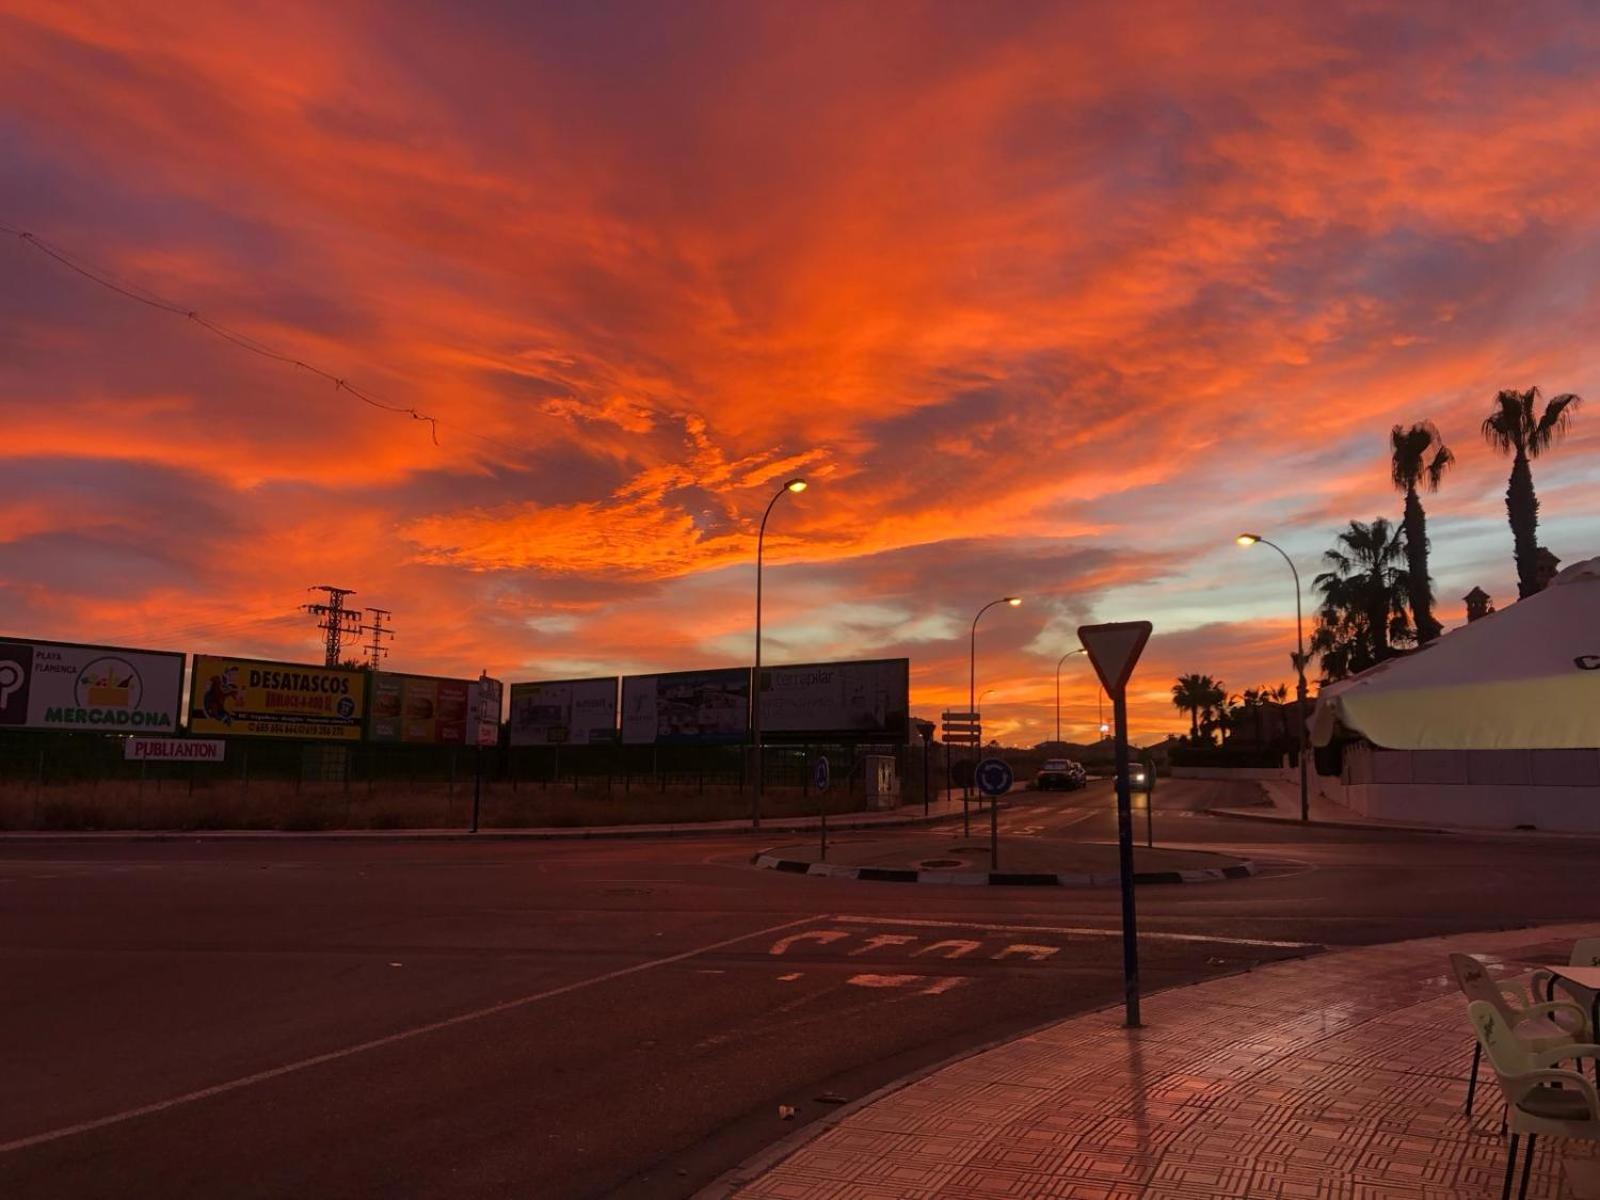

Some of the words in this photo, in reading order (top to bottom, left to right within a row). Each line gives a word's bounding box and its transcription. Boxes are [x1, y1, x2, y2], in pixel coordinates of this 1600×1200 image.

[36, 651, 61, 661] PLAYA
[34, 663, 78, 674] FLAMENCA
[250, 670, 350, 694] DESATASCOS
[45, 707, 171, 727] MERCADONA
[134, 742, 217, 758] PUBLIANTON
